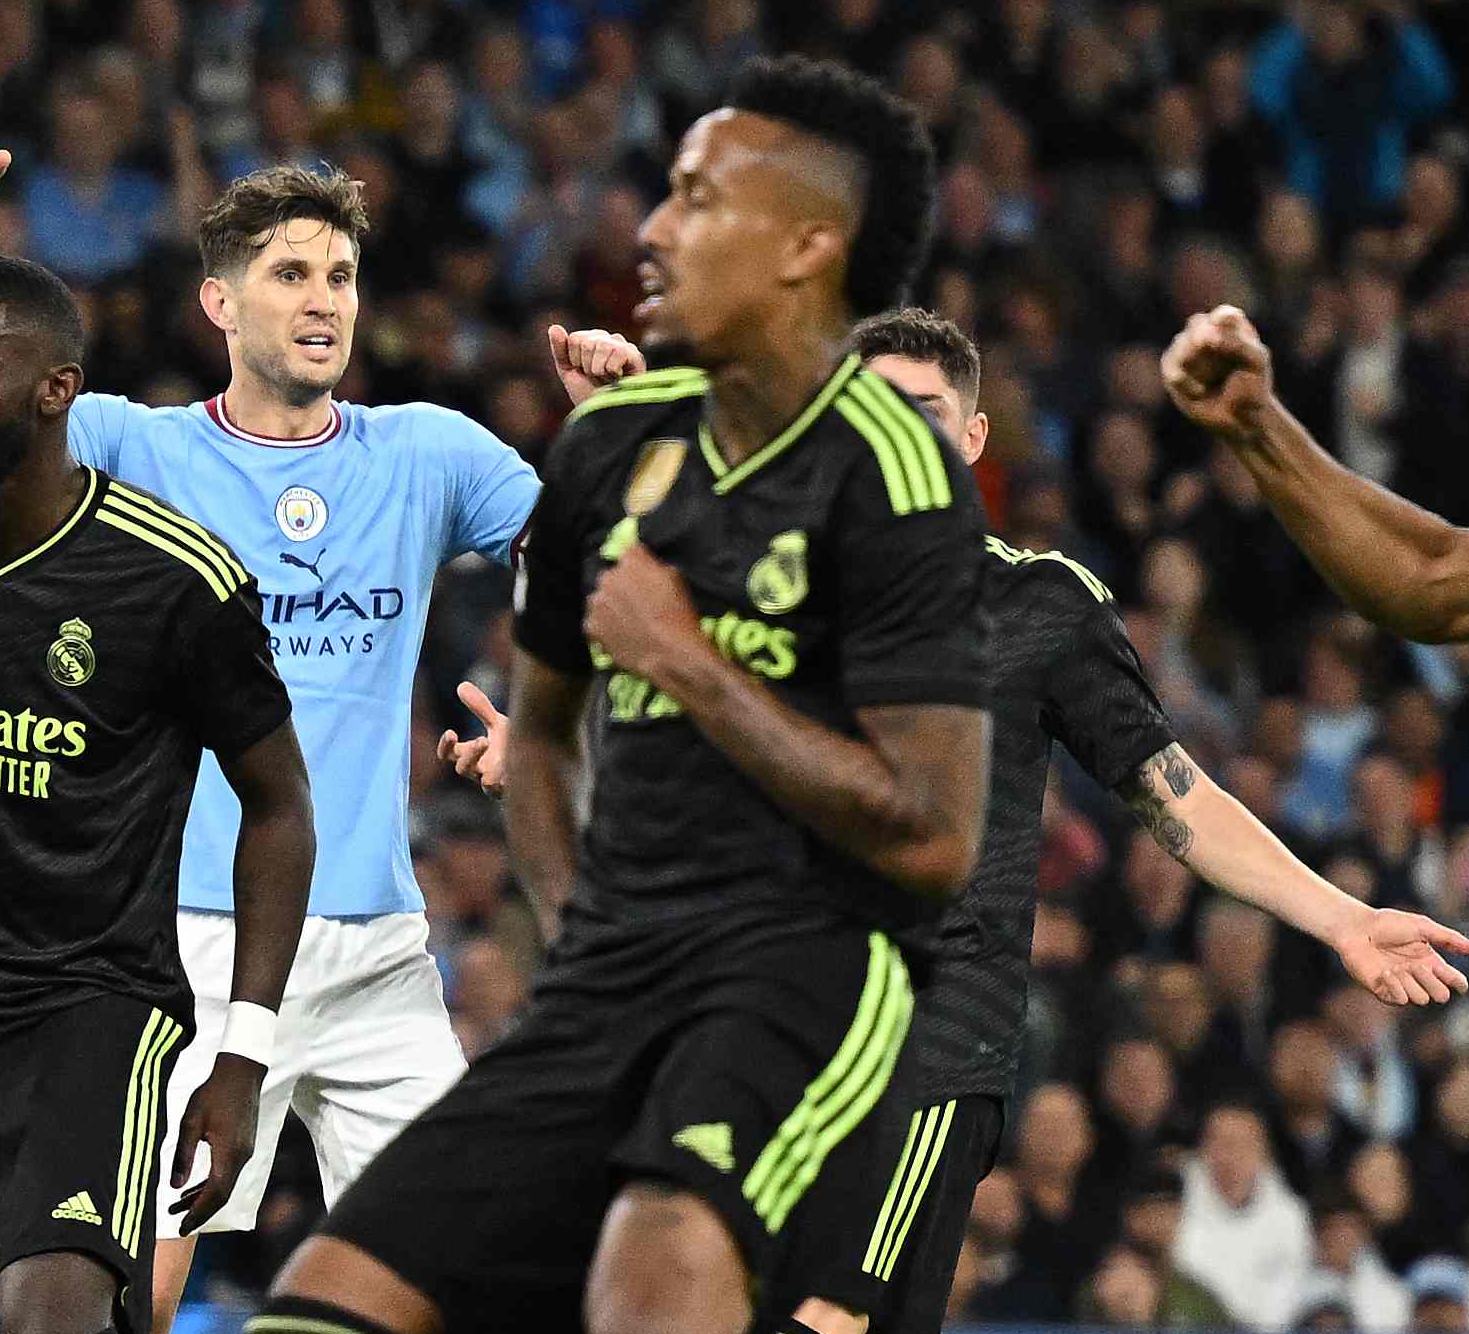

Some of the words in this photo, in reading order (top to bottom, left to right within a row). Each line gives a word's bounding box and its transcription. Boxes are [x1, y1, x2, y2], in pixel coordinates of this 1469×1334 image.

[259, 587, 404, 624] IHAD
[268, 633, 374, 656] RWAYS
[51, 1208, 103, 1226] adidas
